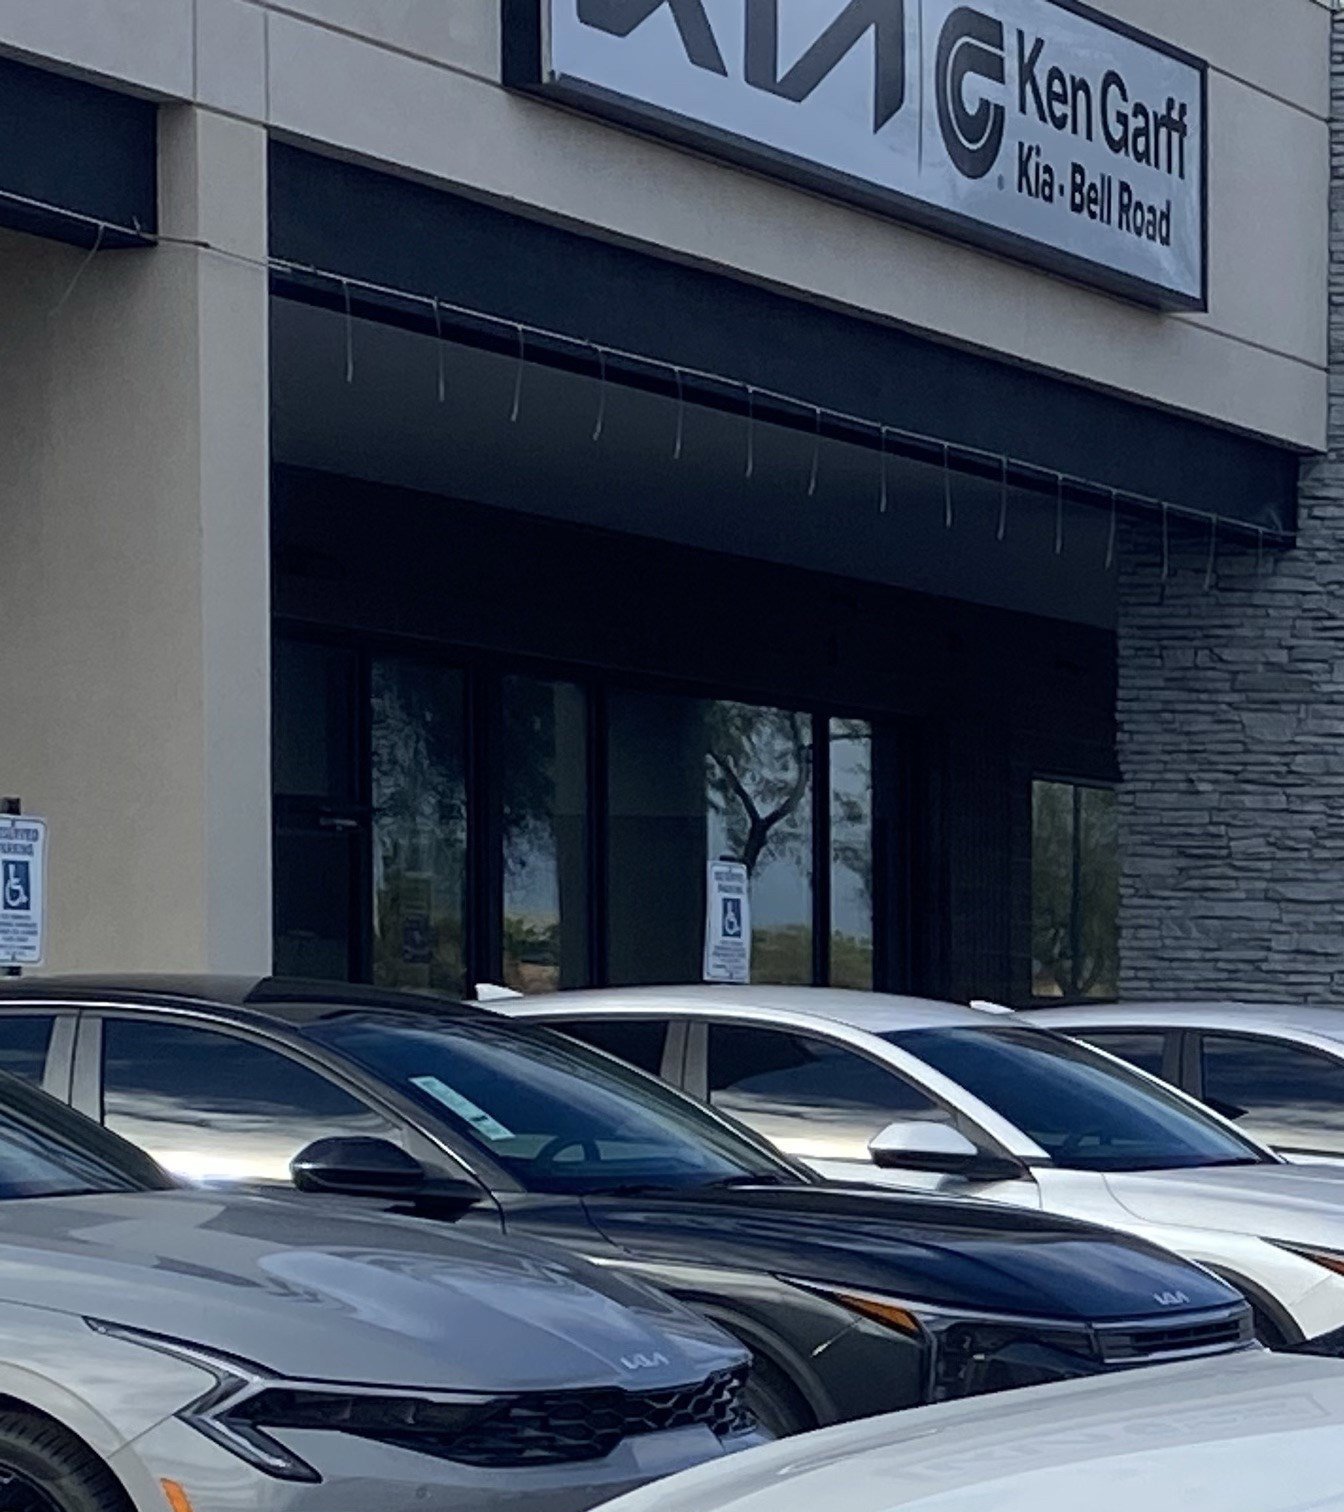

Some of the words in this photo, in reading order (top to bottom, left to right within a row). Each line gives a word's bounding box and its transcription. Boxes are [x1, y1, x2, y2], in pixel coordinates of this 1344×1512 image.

[1016, 28, 1093, 142] Ken
[1100, 69, 1188, 180] Garff
[1017, 141, 1055, 204] Kia
[1070, 162, 1112, 226] Bell
[1118, 180, 1172, 246] Road
